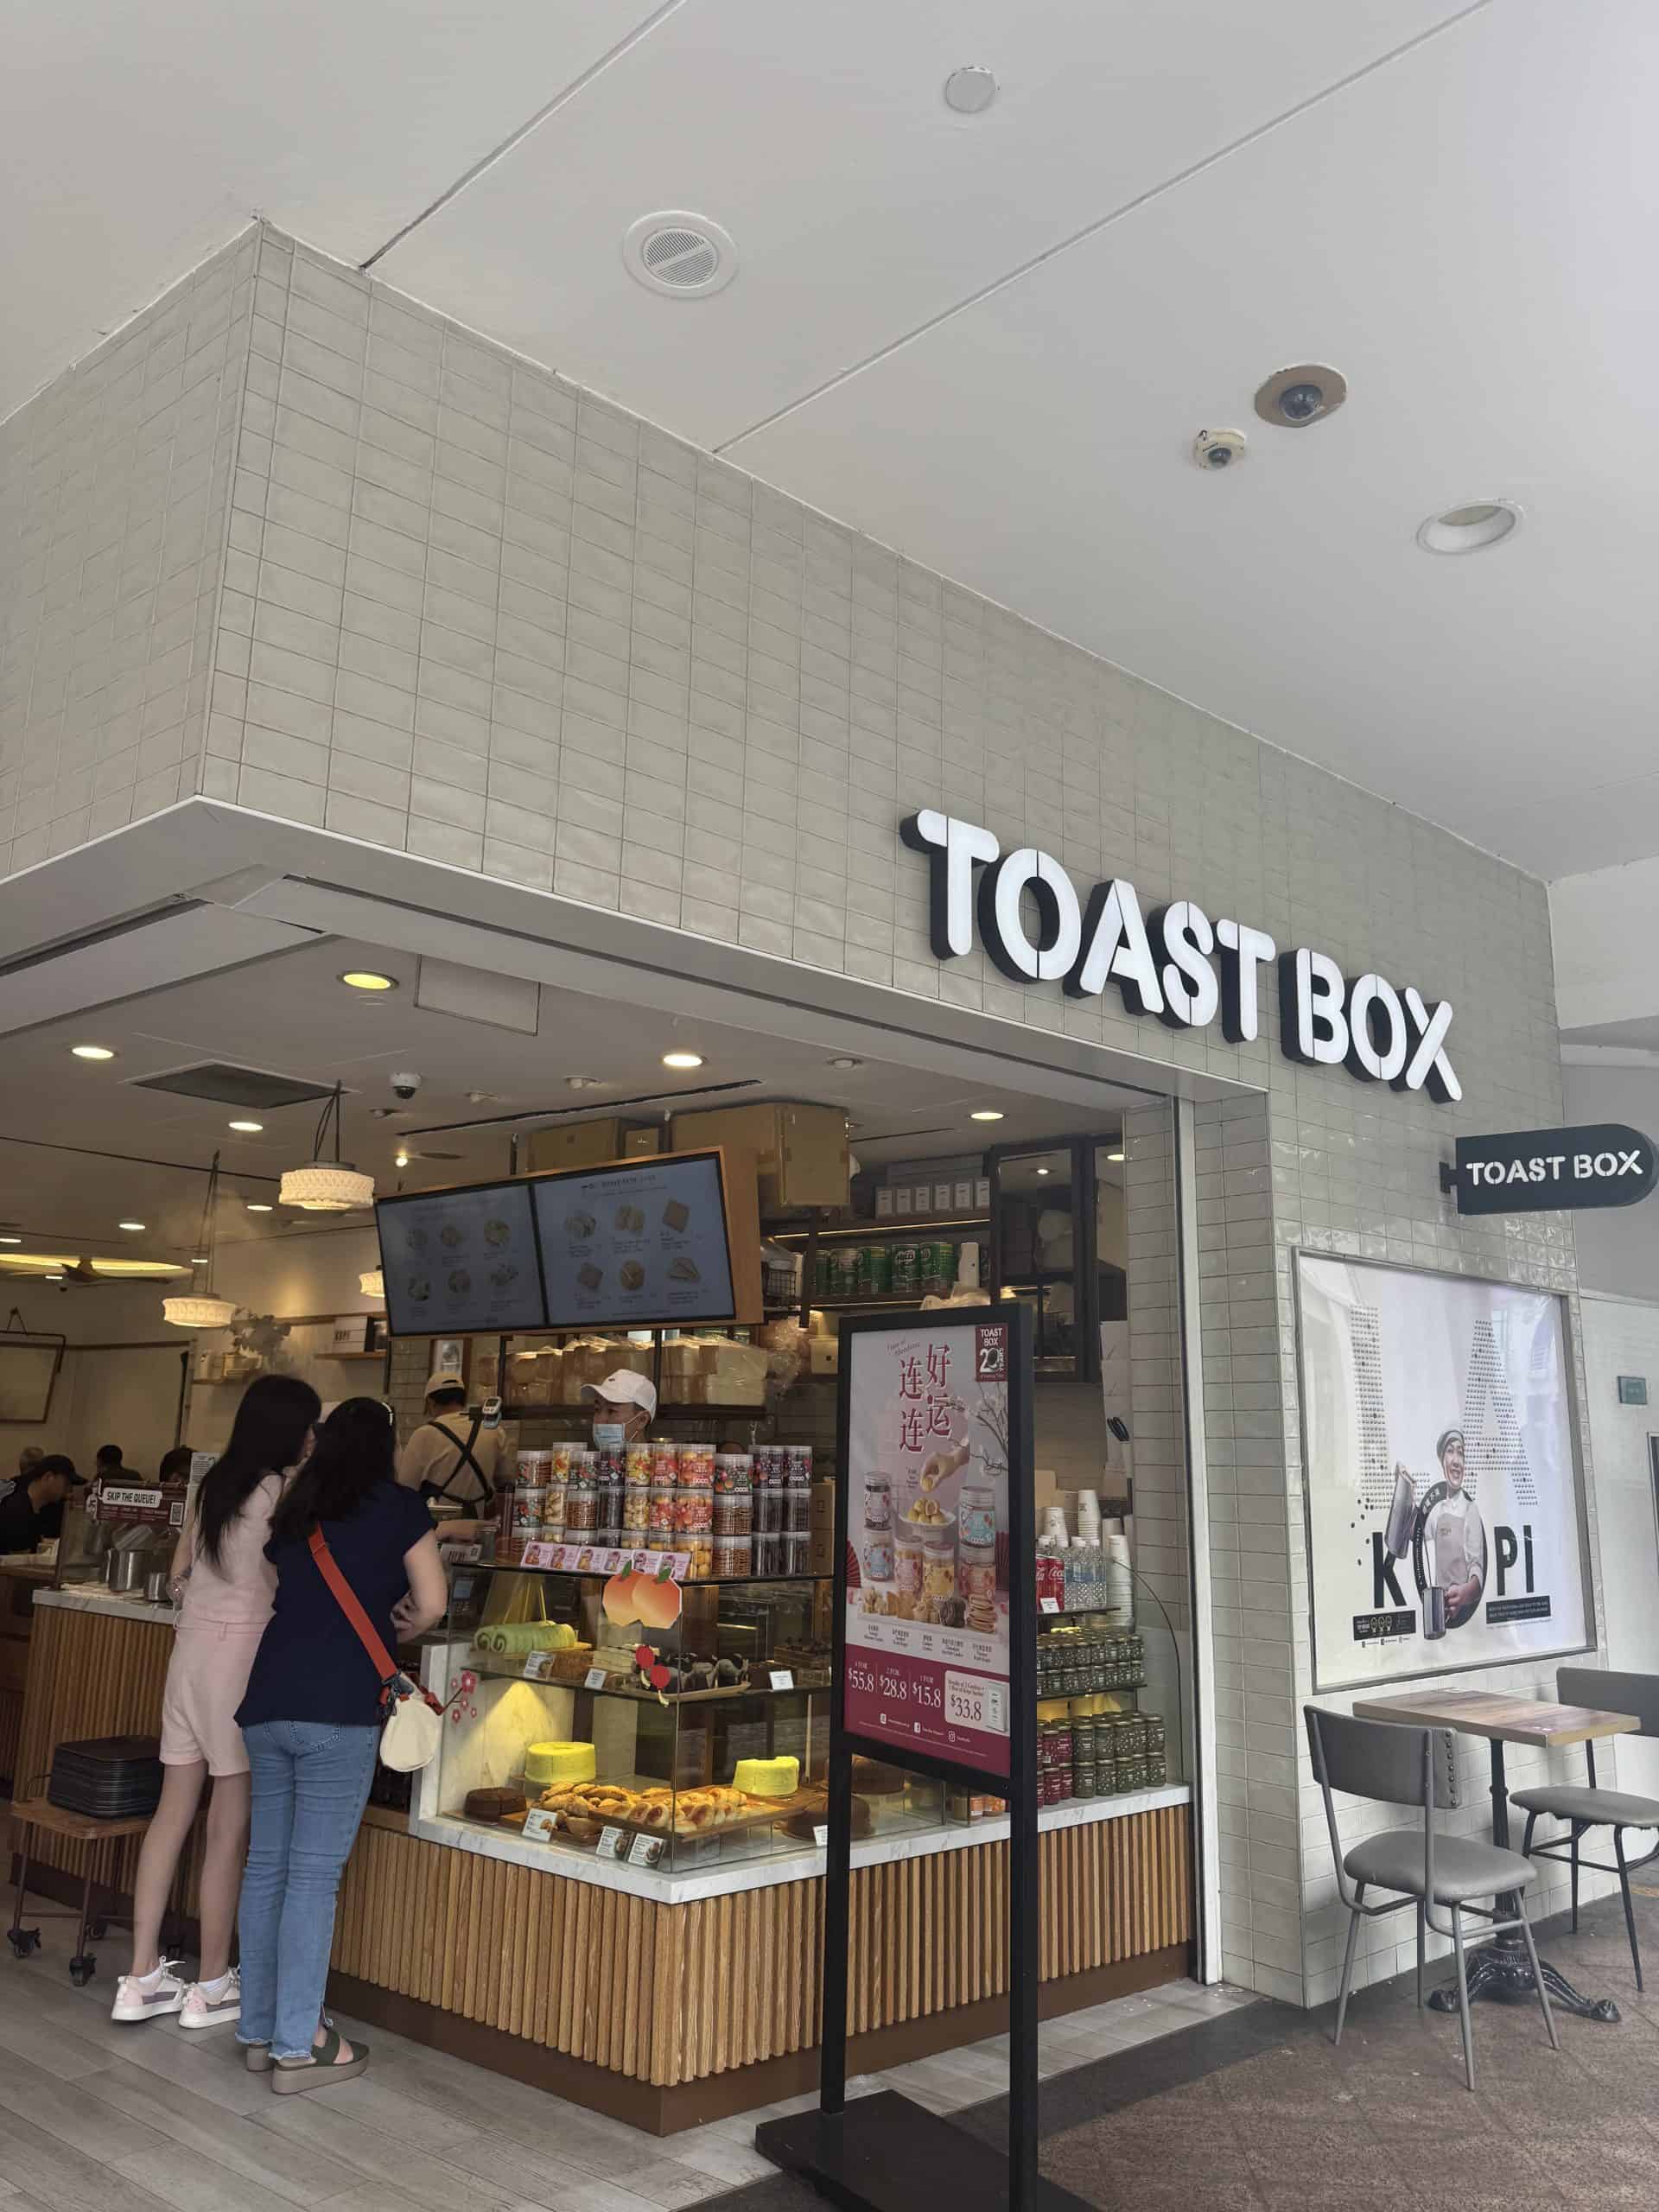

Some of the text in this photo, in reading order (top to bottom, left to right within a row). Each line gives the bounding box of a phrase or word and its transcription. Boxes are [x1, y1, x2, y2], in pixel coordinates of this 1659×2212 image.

[904, 809, 1463, 1103] TOAST BOX
[1467, 1149, 1644, 1187] TOAST BOX
[981, 1327, 1002, 1338] TOAST
[983, 1337, 999, 1347] BOX
[979, 1347, 1000, 1373] 20
[925, 1342, 953, 1437] 好运
[898, 1356, 926, 1452] 连连
[106, 1491, 156, 1504] SKIP THE QUEUE!
[849, 1668, 874, 1693] $55.8
[880, 1675, 906, 1700] $28.8
[912, 1681, 941, 1708] $15.8
[951, 1694, 982, 1721] $33.8
